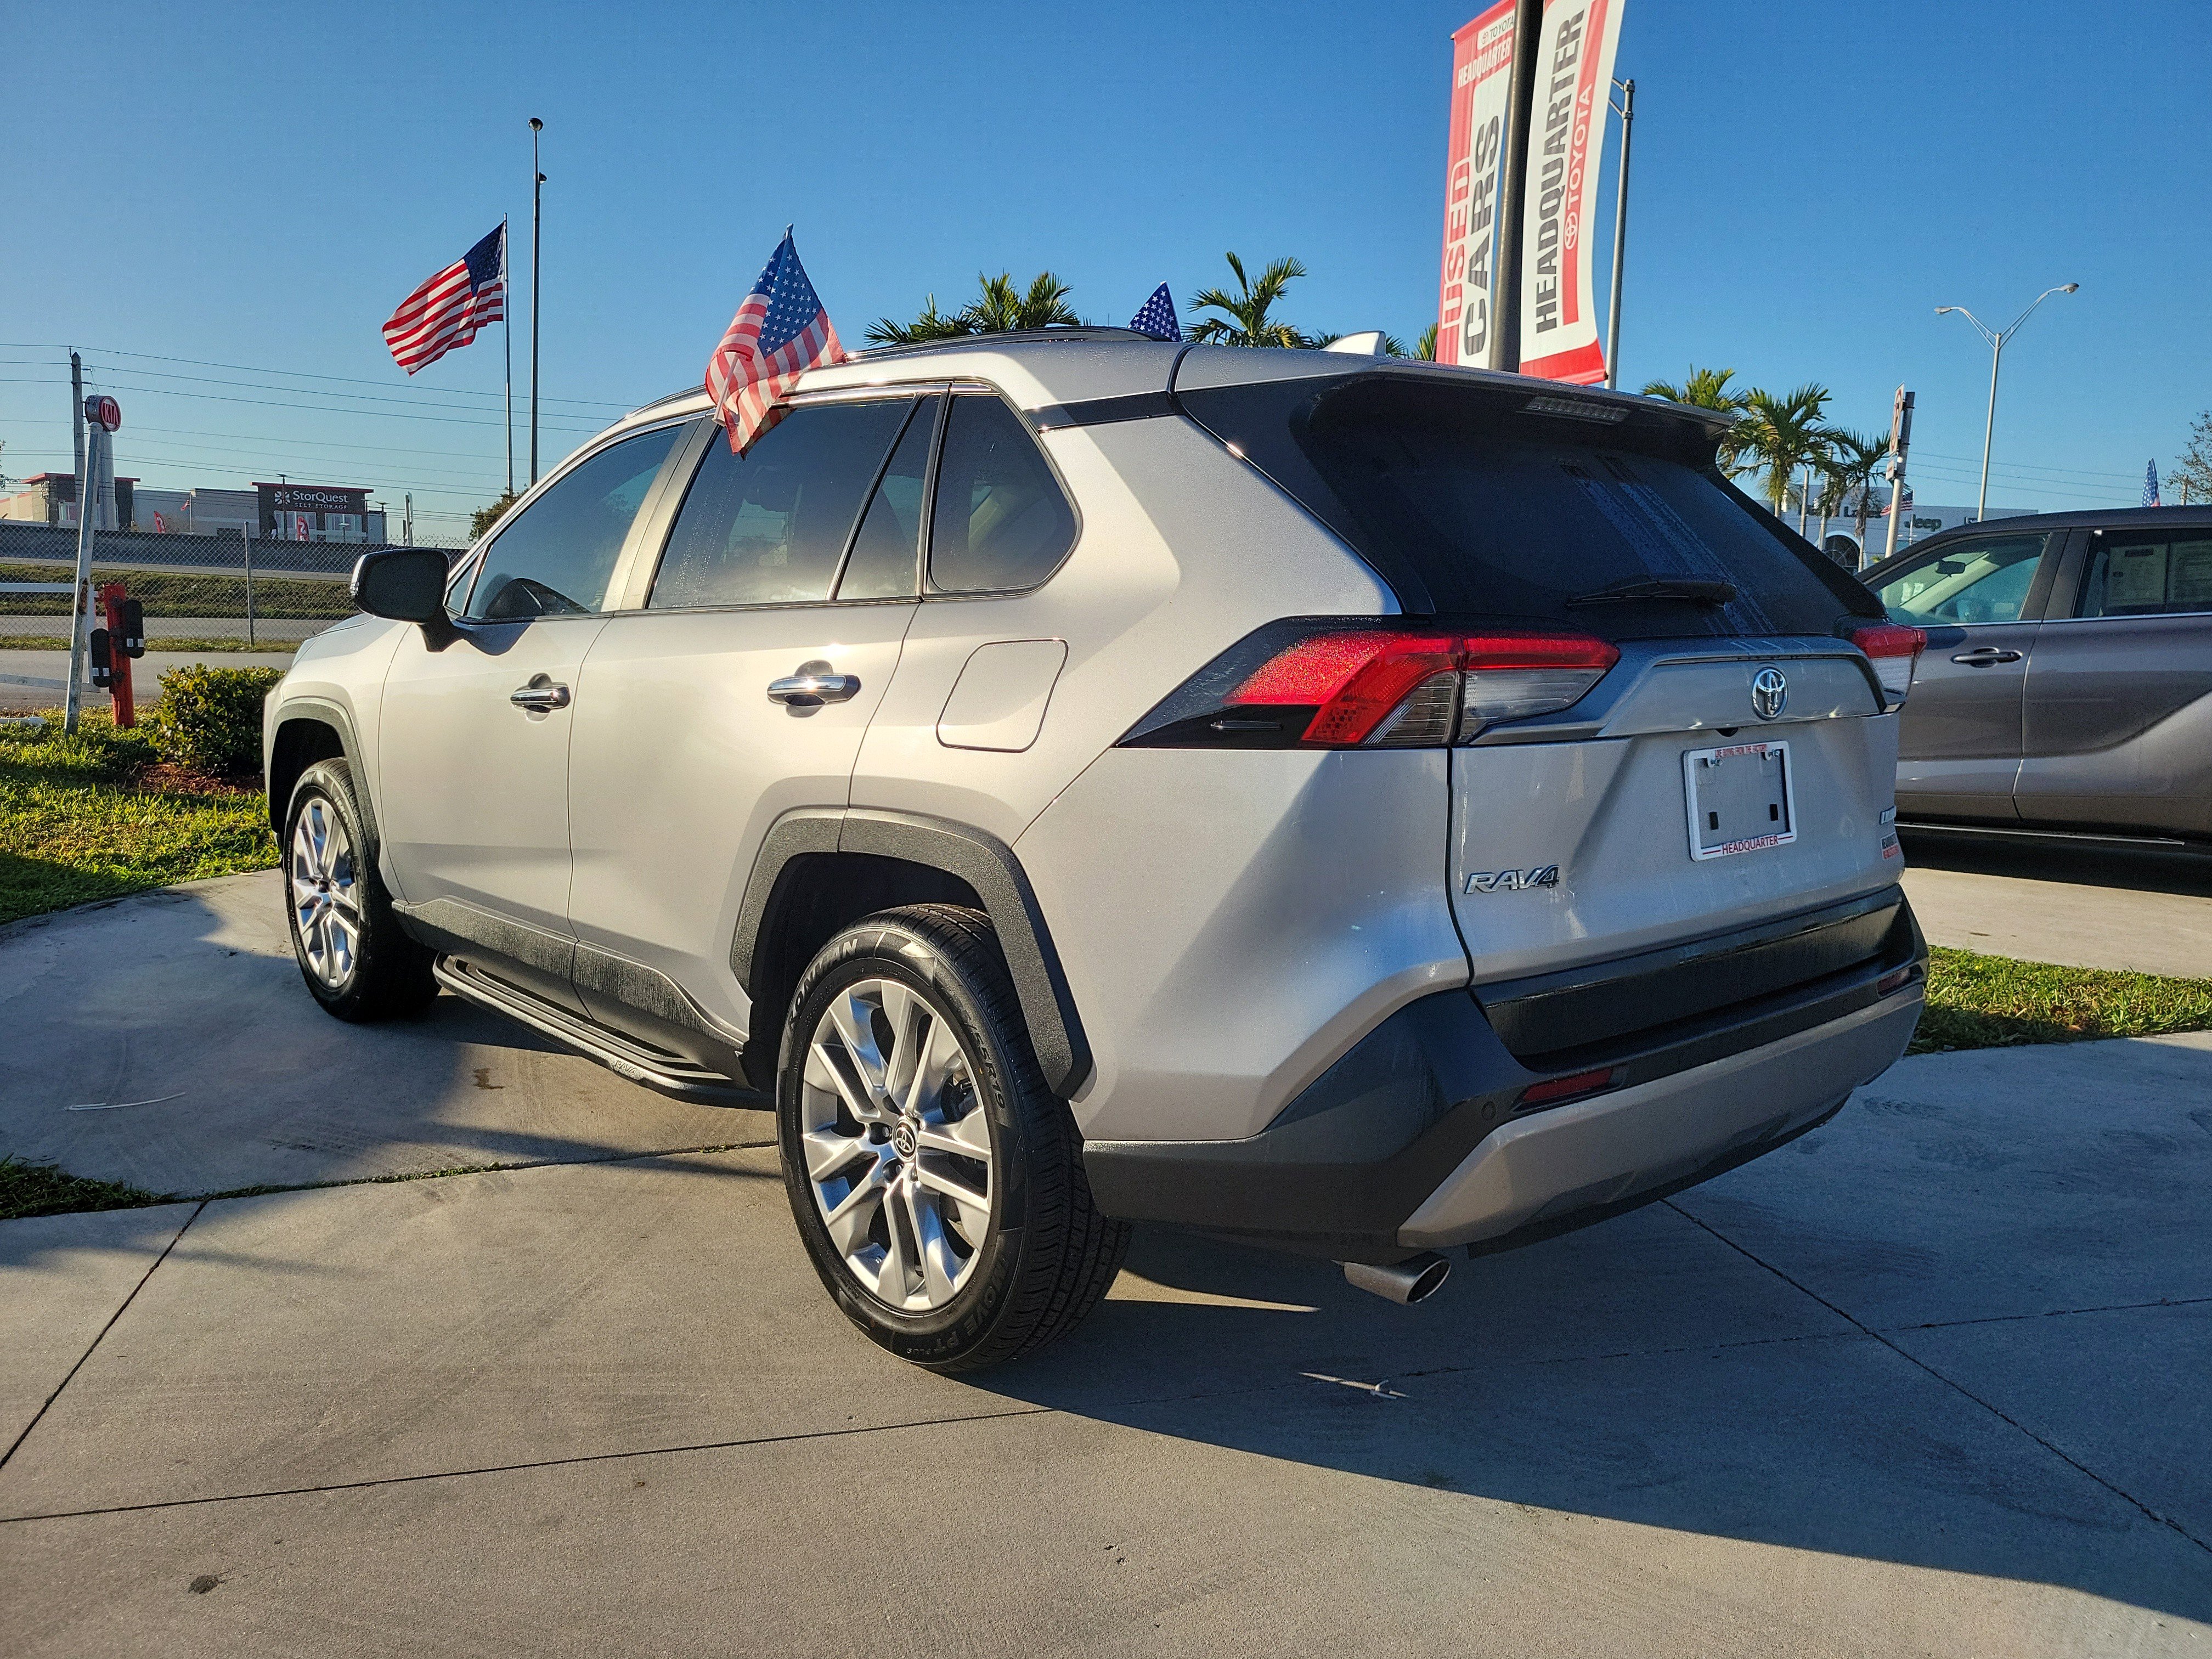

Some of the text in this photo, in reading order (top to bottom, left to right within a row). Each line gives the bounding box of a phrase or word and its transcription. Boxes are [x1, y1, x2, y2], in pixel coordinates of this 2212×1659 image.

[1489, 15, 1514, 40] TOYOTA
[1458, 36, 1512, 89] HEADQUARTER
[1566, 83, 1592, 207] TOYOTA
[1536, 9, 1584, 334] HEADQUARTER
[1441, 157, 1470, 329] USED
[1464, 116, 1499, 356] CARS
[104, 402, 119, 426] KIA
[293, 490, 349, 504] StorQuest
[1904, 515, 1942, 532] Jeep
[1722, 836, 1779, 855] HEADQUARTER
[1464, 864, 1560, 894] RAV4
[788, 938, 859, 1031] RONMAN
